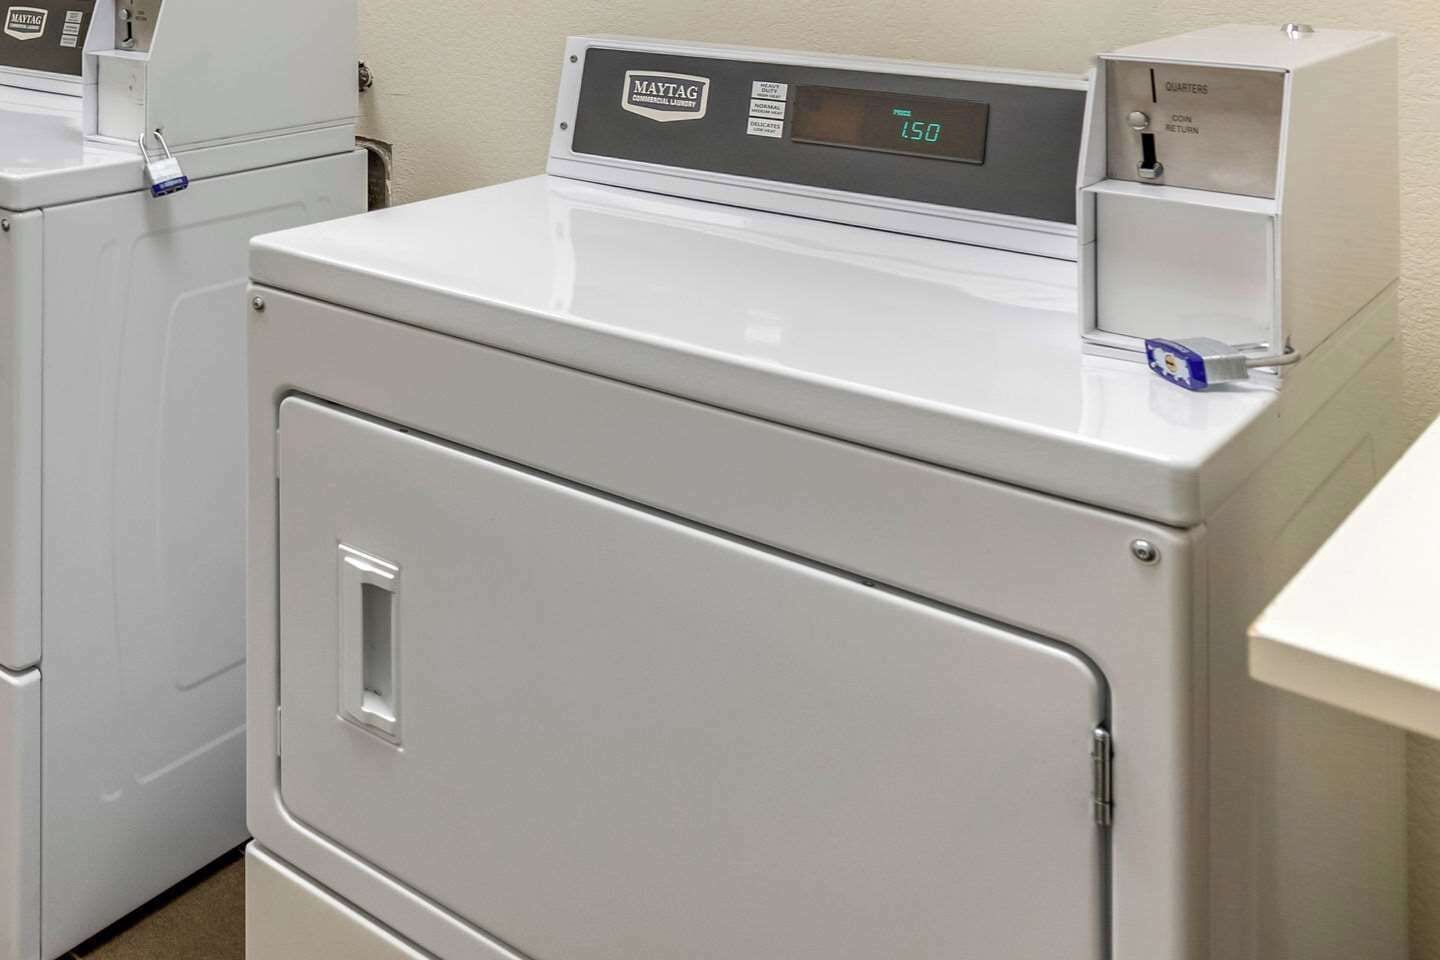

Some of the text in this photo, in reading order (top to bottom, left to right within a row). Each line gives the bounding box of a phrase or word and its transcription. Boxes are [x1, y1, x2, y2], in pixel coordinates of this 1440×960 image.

[11, 13, 42, 25] MAYTAG
[633, 80, 698, 99] MAYTAG
[1165, 81, 1208, 94] QUARTERS
[632, 94, 696, 108] COMMERCIAL LAUNDRY
[1171, 114, 1192, 123] COIN
[750, 121, 780, 129] DELICATES
[1165, 124, 1199, 134] RETURN
[901, 121, 941, 142] 1.50
